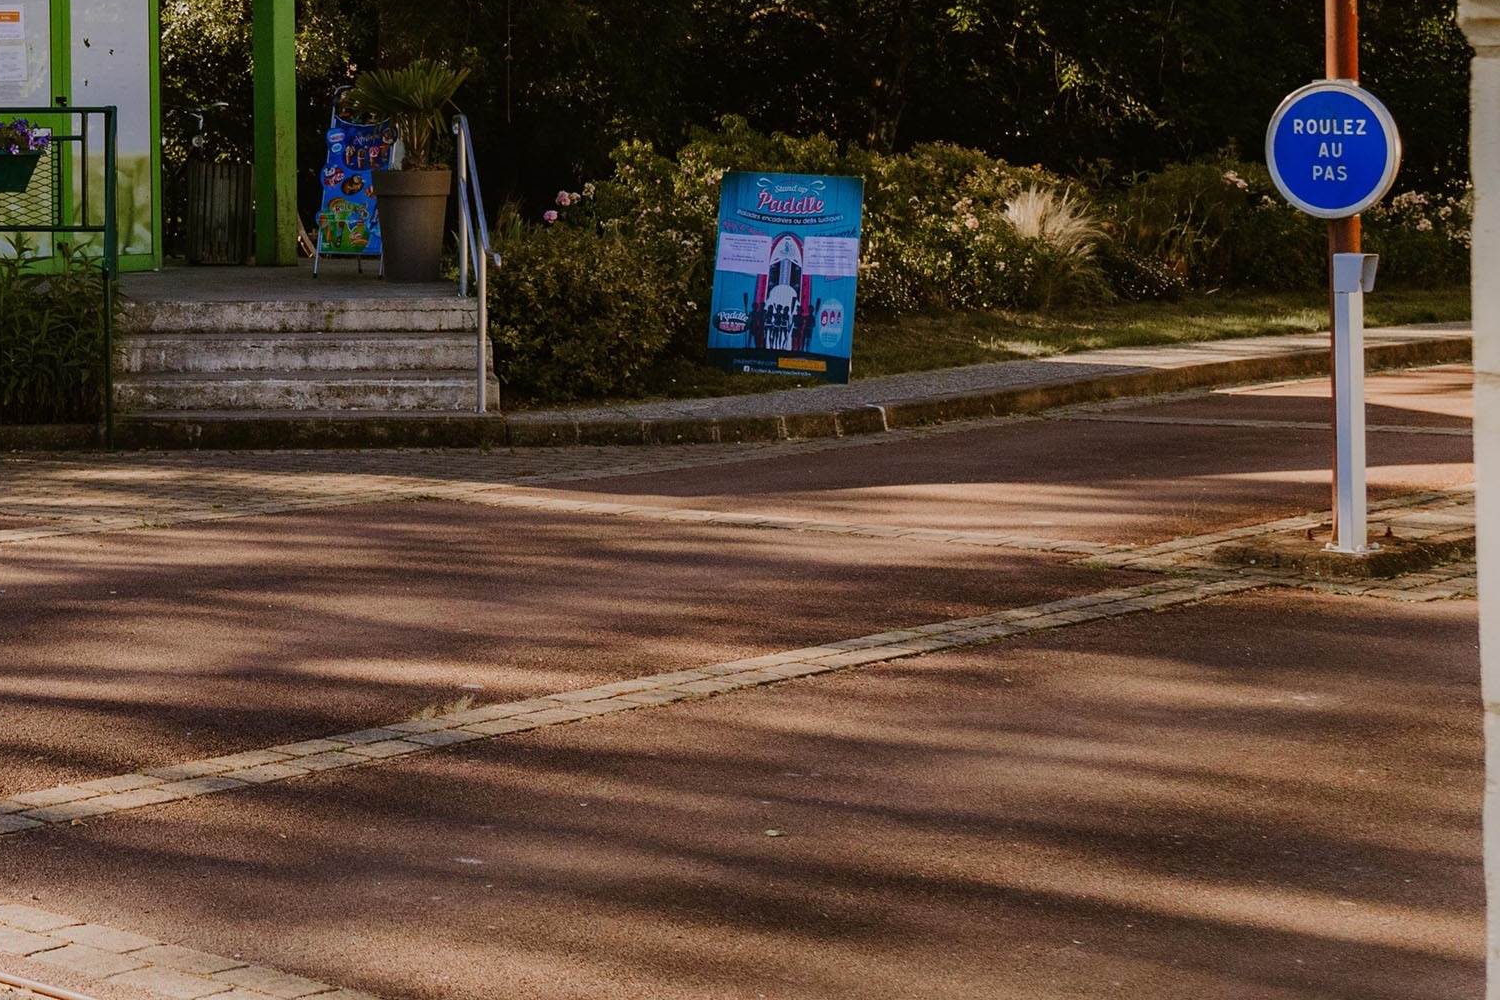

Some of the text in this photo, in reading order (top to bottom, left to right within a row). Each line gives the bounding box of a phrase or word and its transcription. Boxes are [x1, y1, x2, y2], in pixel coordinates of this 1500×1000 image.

[1293, 118, 1367, 135] ROULEZ
[1318, 142, 1342, 158] AU
[1312, 165, 1348, 181] PAS
[774, 185, 797, 193] Stand
[757, 191, 825, 214] Paddle
[717, 311, 749, 322] Paddle
